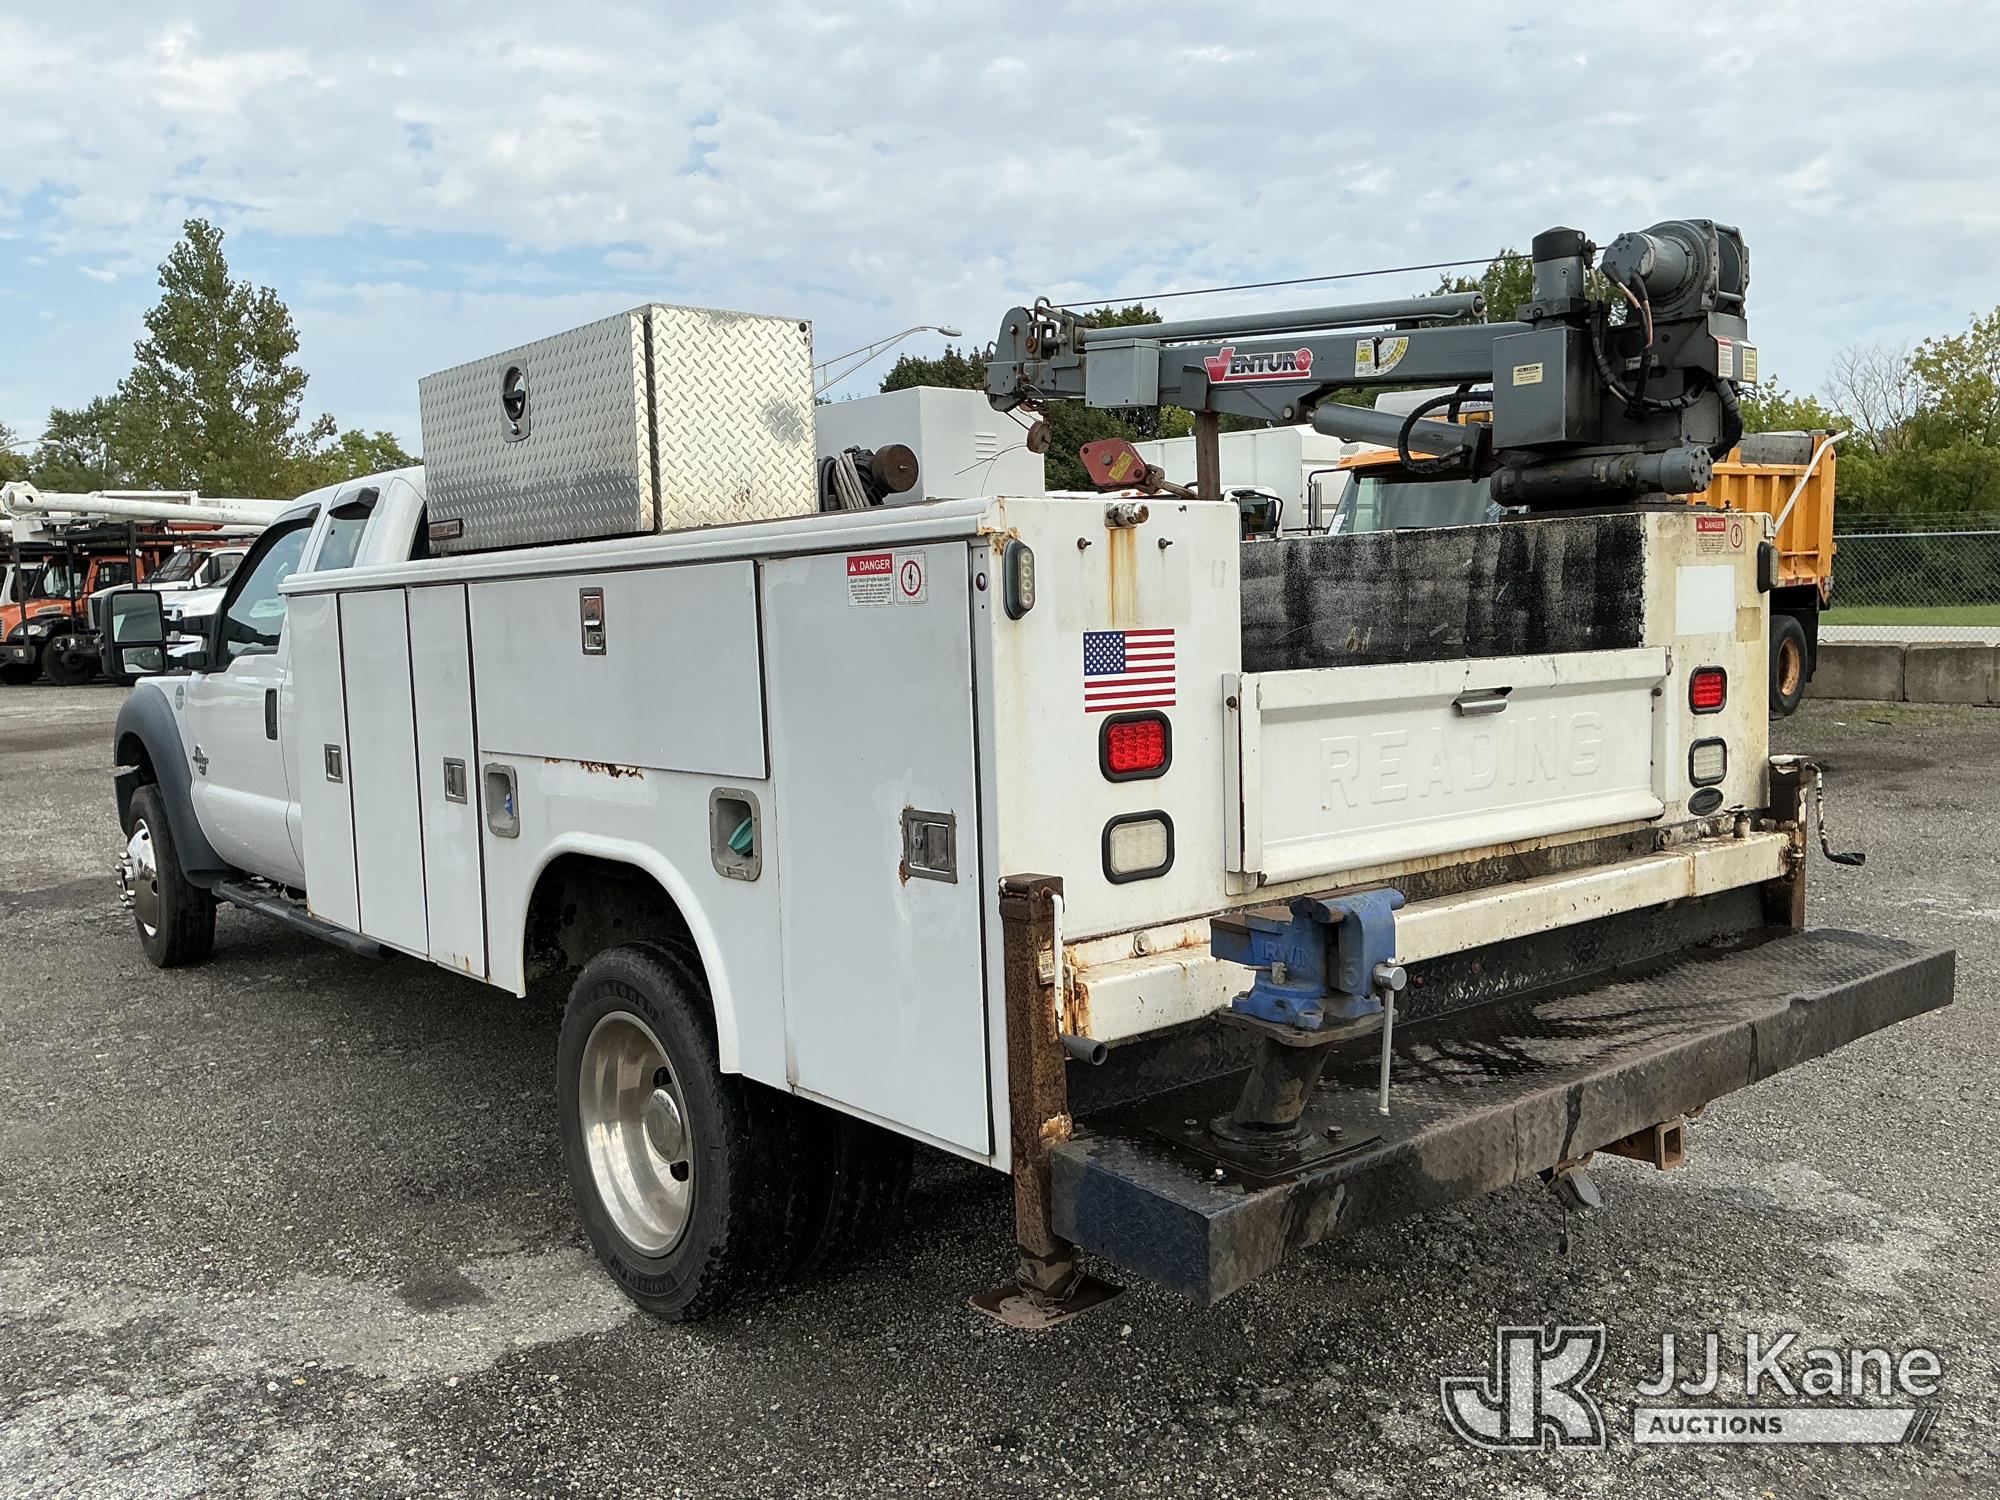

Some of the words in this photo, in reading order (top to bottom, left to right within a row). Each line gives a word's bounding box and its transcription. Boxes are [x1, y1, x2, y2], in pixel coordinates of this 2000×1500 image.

[1204, 347, 1312, 382] VENTURO
[1705, 521, 1725, 529] DANGER
[860, 559, 890, 570] DANGER
[1320, 710, 1605, 811] READING
